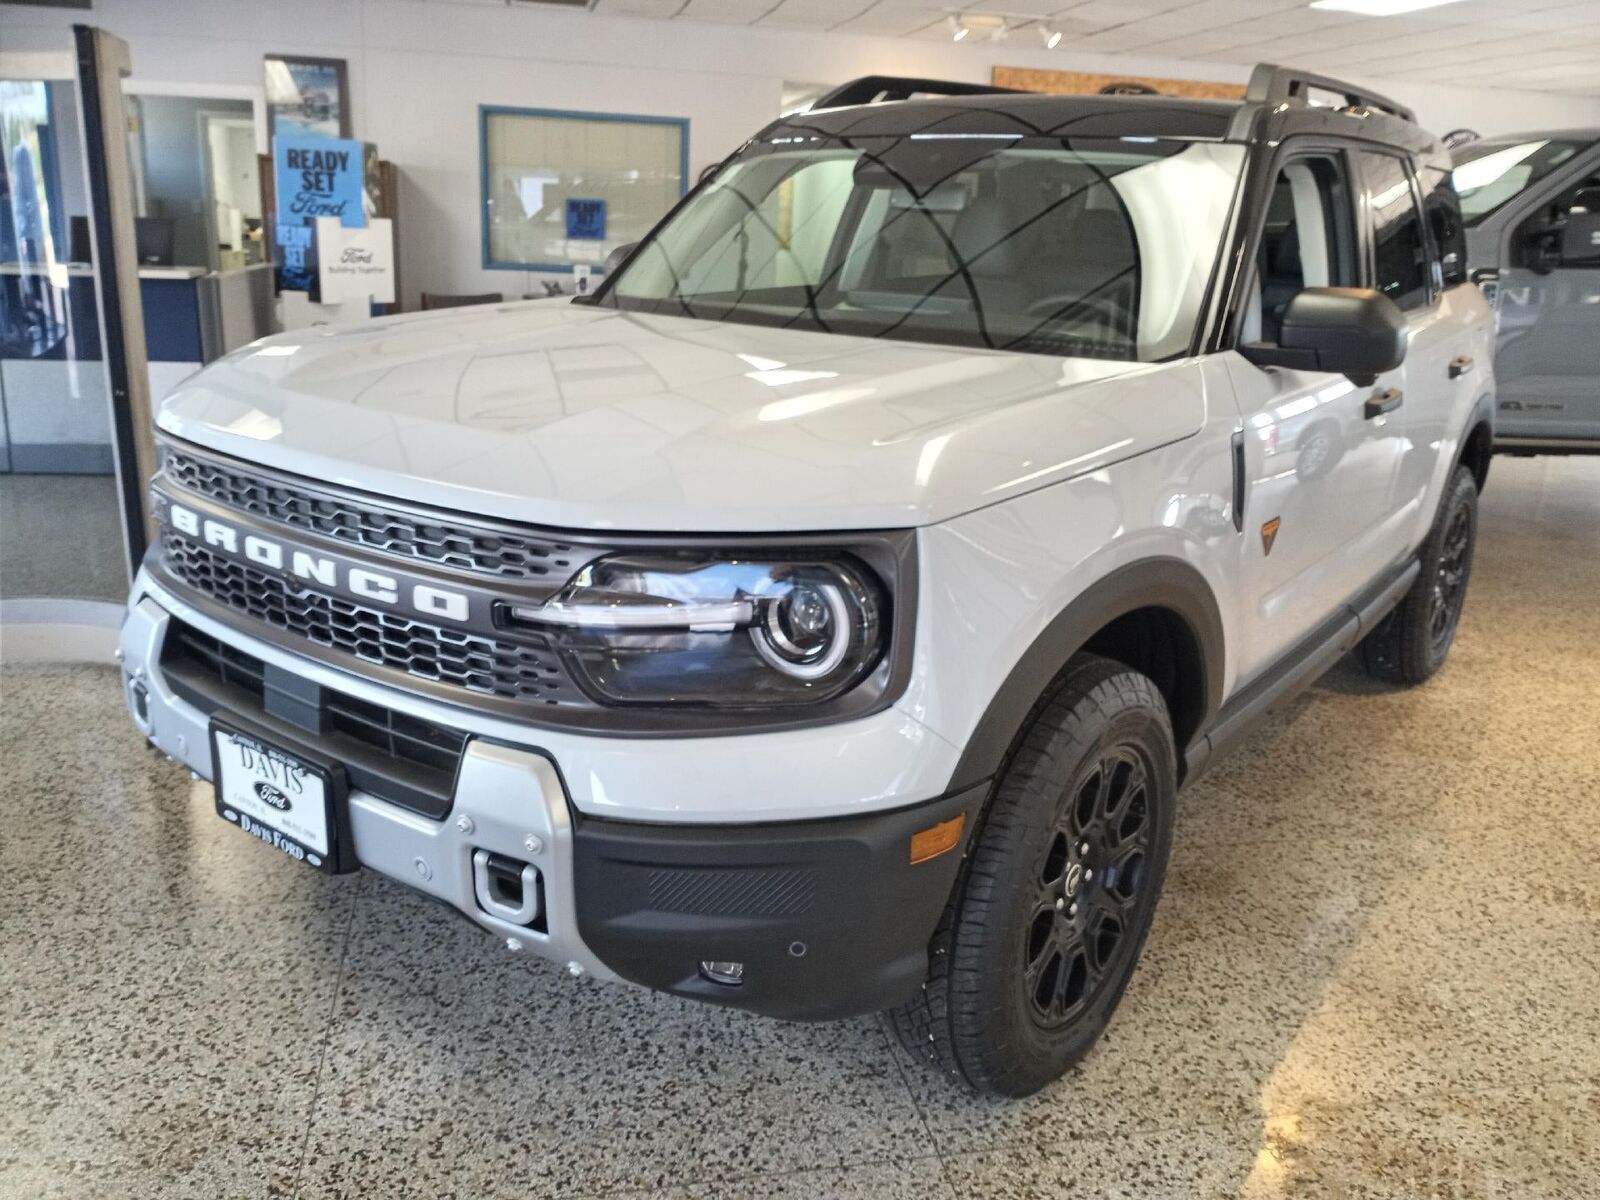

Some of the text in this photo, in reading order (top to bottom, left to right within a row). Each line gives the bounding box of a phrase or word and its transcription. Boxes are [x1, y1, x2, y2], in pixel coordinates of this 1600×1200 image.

[287, 148, 349, 172] READY
[301, 172, 337, 192] SET
[290, 191, 348, 216] Ford
[340, 248, 373, 264] Ford
[170, 504, 470, 622] BRONCO
[241, 745, 303, 794] DAVIS
[260, 785, 286, 810] Ford
